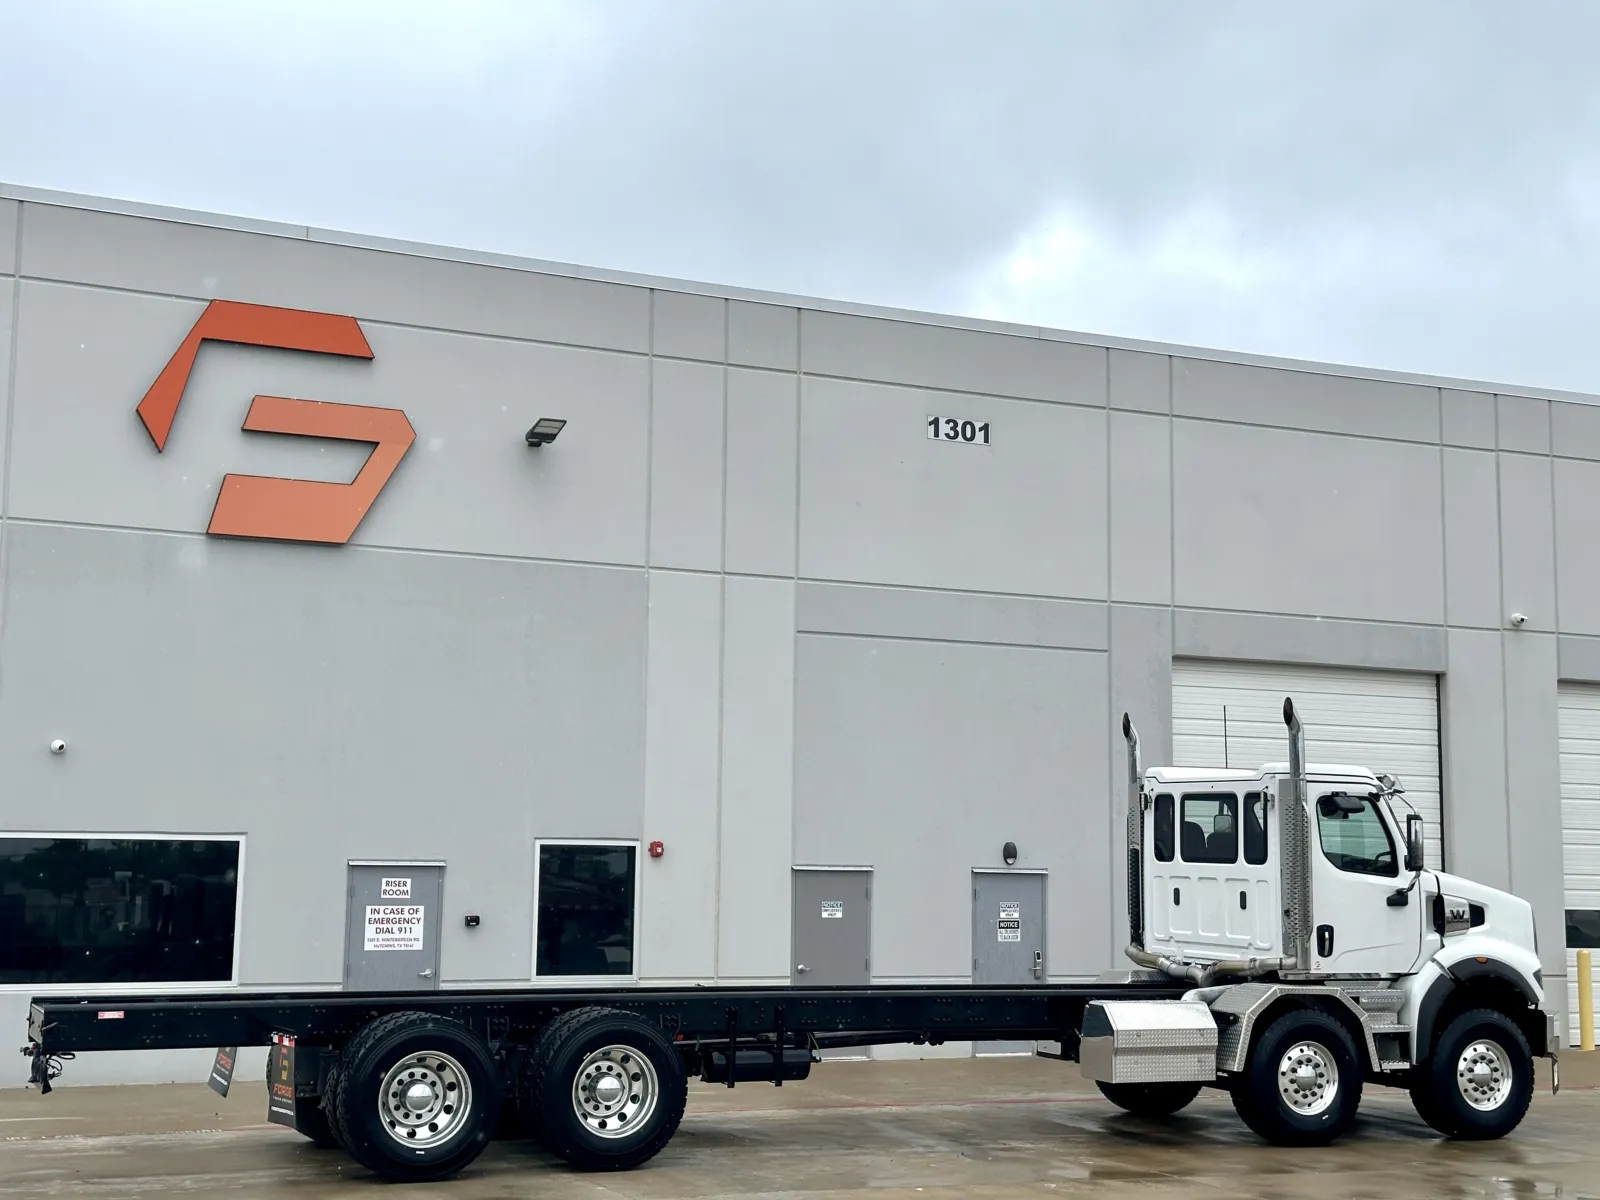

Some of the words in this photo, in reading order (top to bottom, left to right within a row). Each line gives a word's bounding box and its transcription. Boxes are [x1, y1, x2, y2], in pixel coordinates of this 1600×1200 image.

[928, 416, 990, 444] 1301
[385, 880, 408, 888] RISER
[382, 888, 410, 896] ROOM
[370, 907, 381, 915] IN
[383, 907, 405, 915] CASE
[407, 907, 420, 915] OF
[368, 917, 422, 925] EMERGENCY
[375, 926, 395, 935] DIAL
[397, 926, 412, 935] 911
[273, 1083, 293, 1097] FORGE
